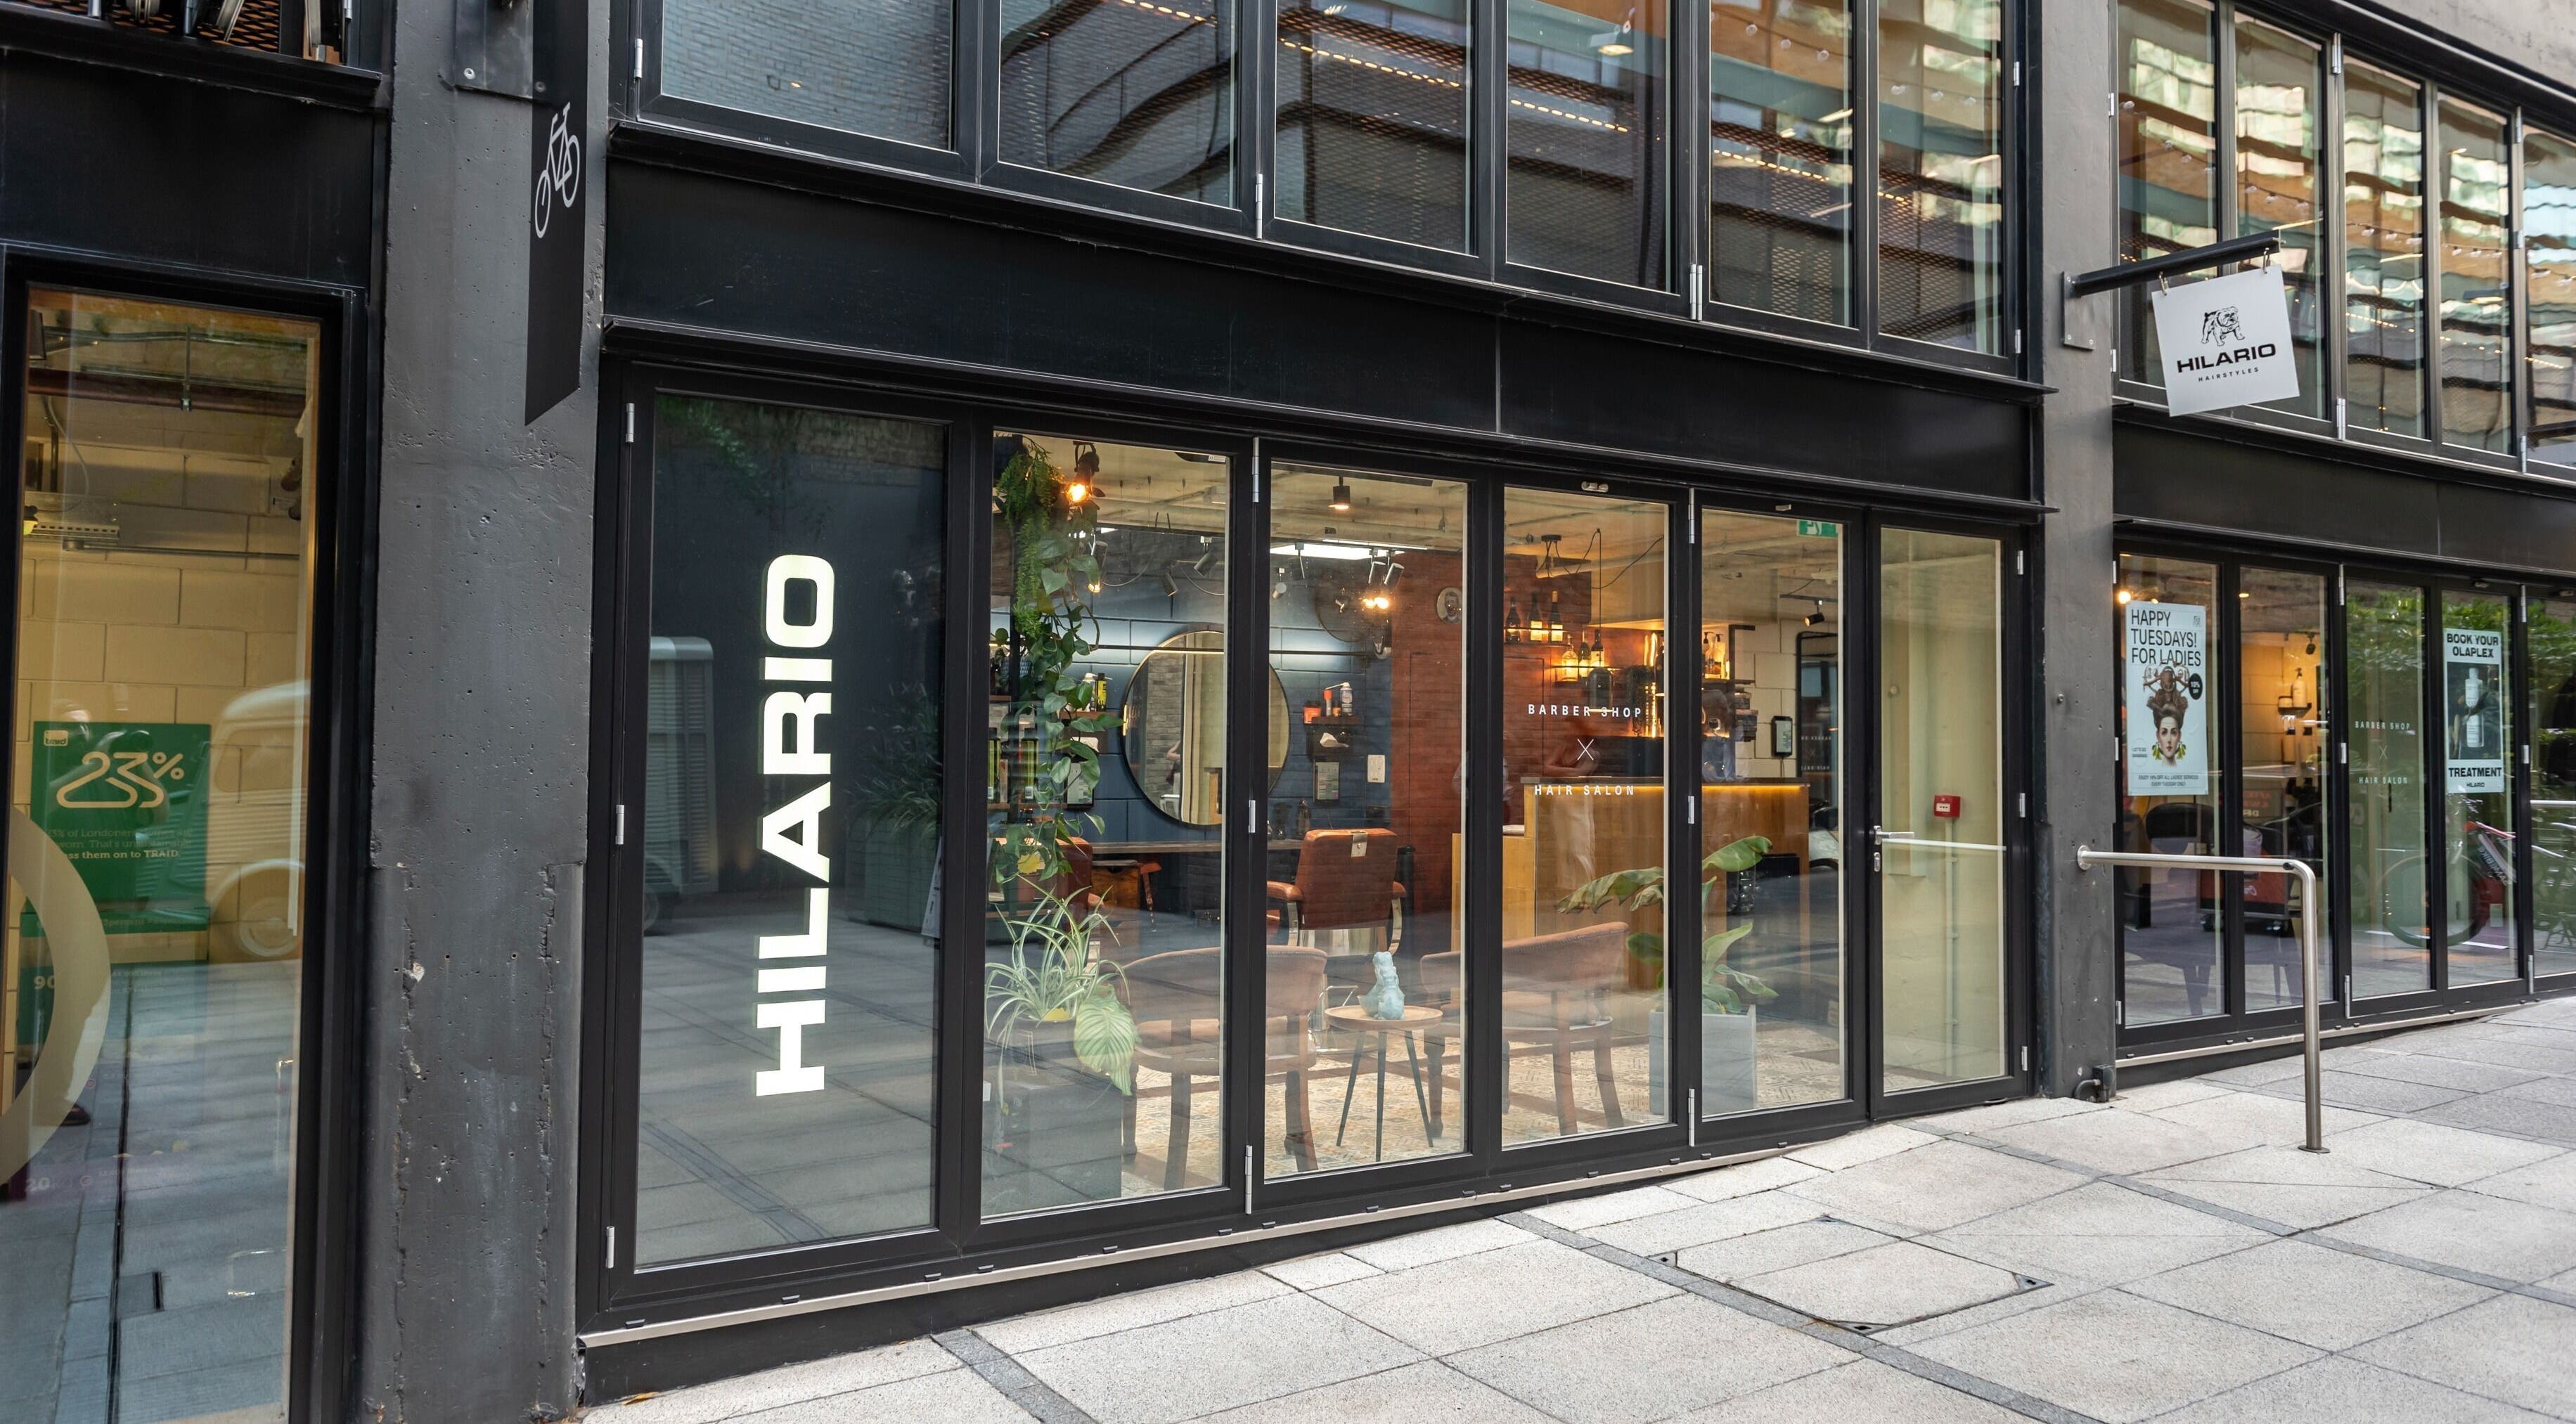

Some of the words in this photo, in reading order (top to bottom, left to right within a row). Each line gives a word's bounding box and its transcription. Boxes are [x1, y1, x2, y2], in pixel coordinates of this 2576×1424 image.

[2177, 343, 2276, 373] HILARIO
[2198, 366, 2259, 382] HAIRSTYLES
[2131, 609, 2171, 627] HAPPY
[2130, 628, 2197, 648] TUESDAYS!
[2447, 633, 2473, 645] BOOK
[2474, 635, 2499, 646] YOUR
[2131, 647, 2156, 664] FOR
[2160, 649, 2201, 666] LADIES
[2452, 646, 2494, 658] OLAPLEX
[1528, 704, 1590, 717] BARBER
[1601, 706, 1641, 718] SHOP
[2355, 720, 2385, 729] BARBER
[56, 751, 184, 808] 23%
[2448, 767, 2502, 777] TREATMENT
[1534, 784, 1573, 796] HAIR
[1583, 784, 1634, 796] SALON
[755, 553, 835, 1097] HILARIO
[144, 850, 181, 858] TRAID.
